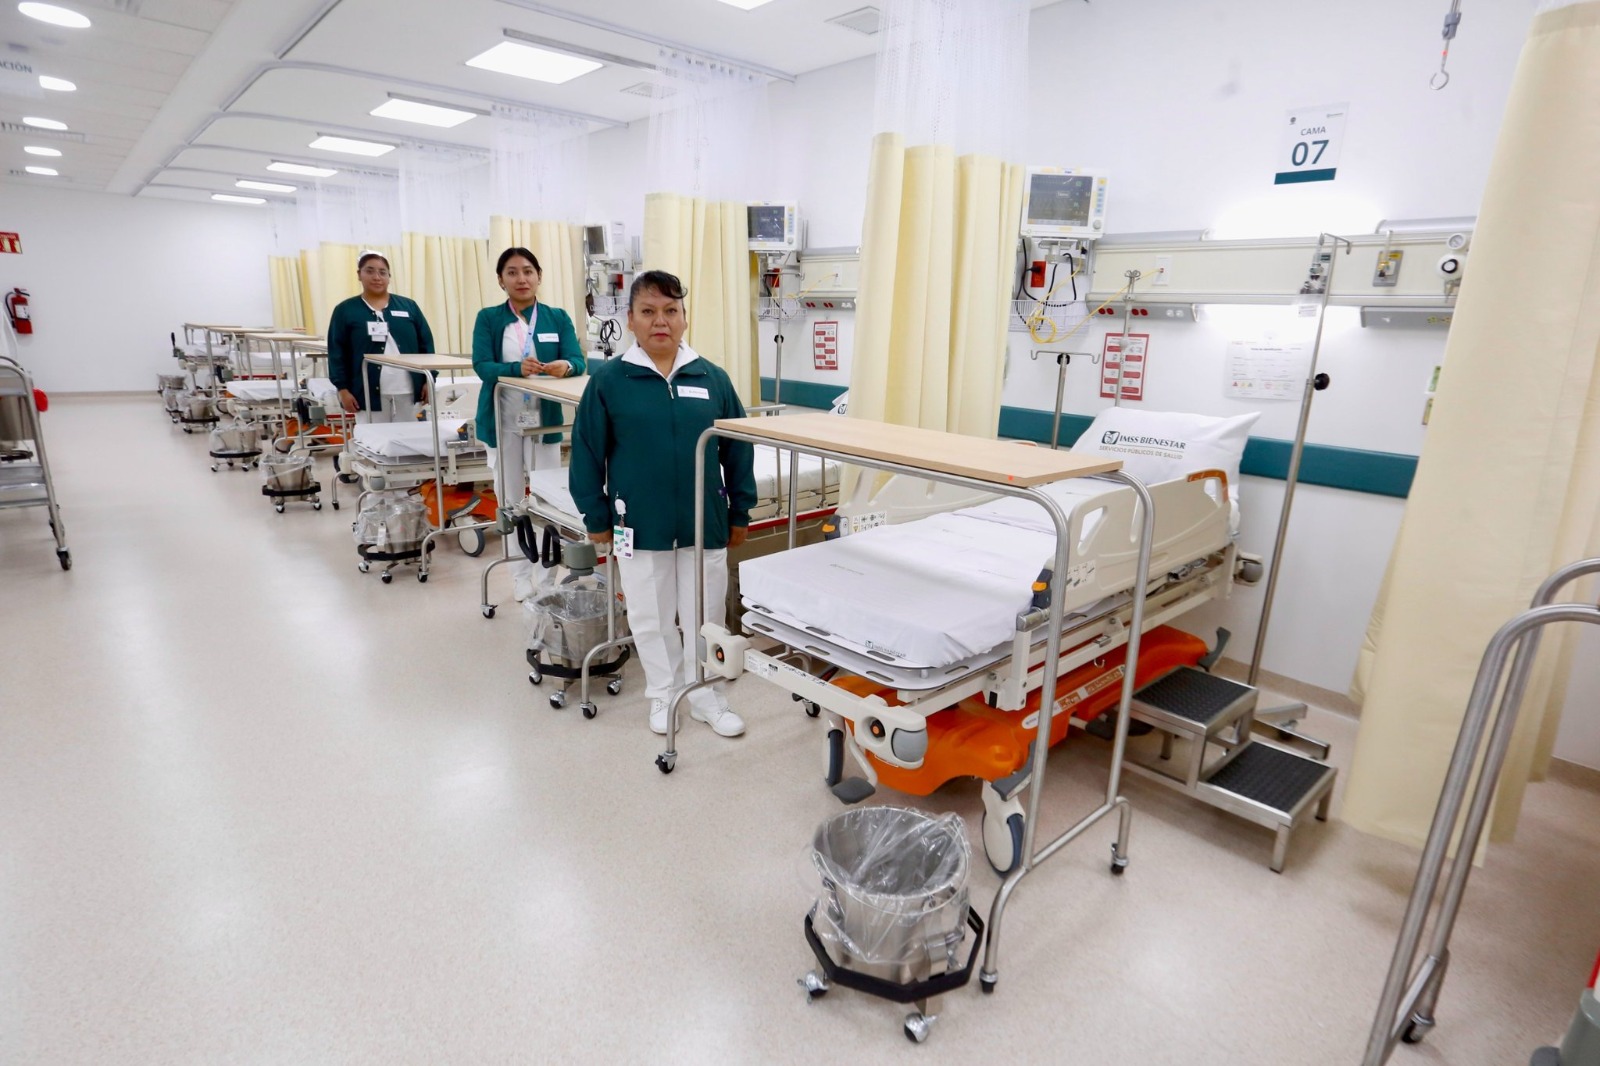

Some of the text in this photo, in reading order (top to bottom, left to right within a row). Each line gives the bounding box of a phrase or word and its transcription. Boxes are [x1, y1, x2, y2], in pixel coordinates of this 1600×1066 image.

[1301, 126, 1326, 136] CAMA
[1291, 139, 1329, 166] 07
[1120, 435, 1186, 450] IMSS BIENESTAR
[1099, 445, 1127, 453] SERVICIOS
